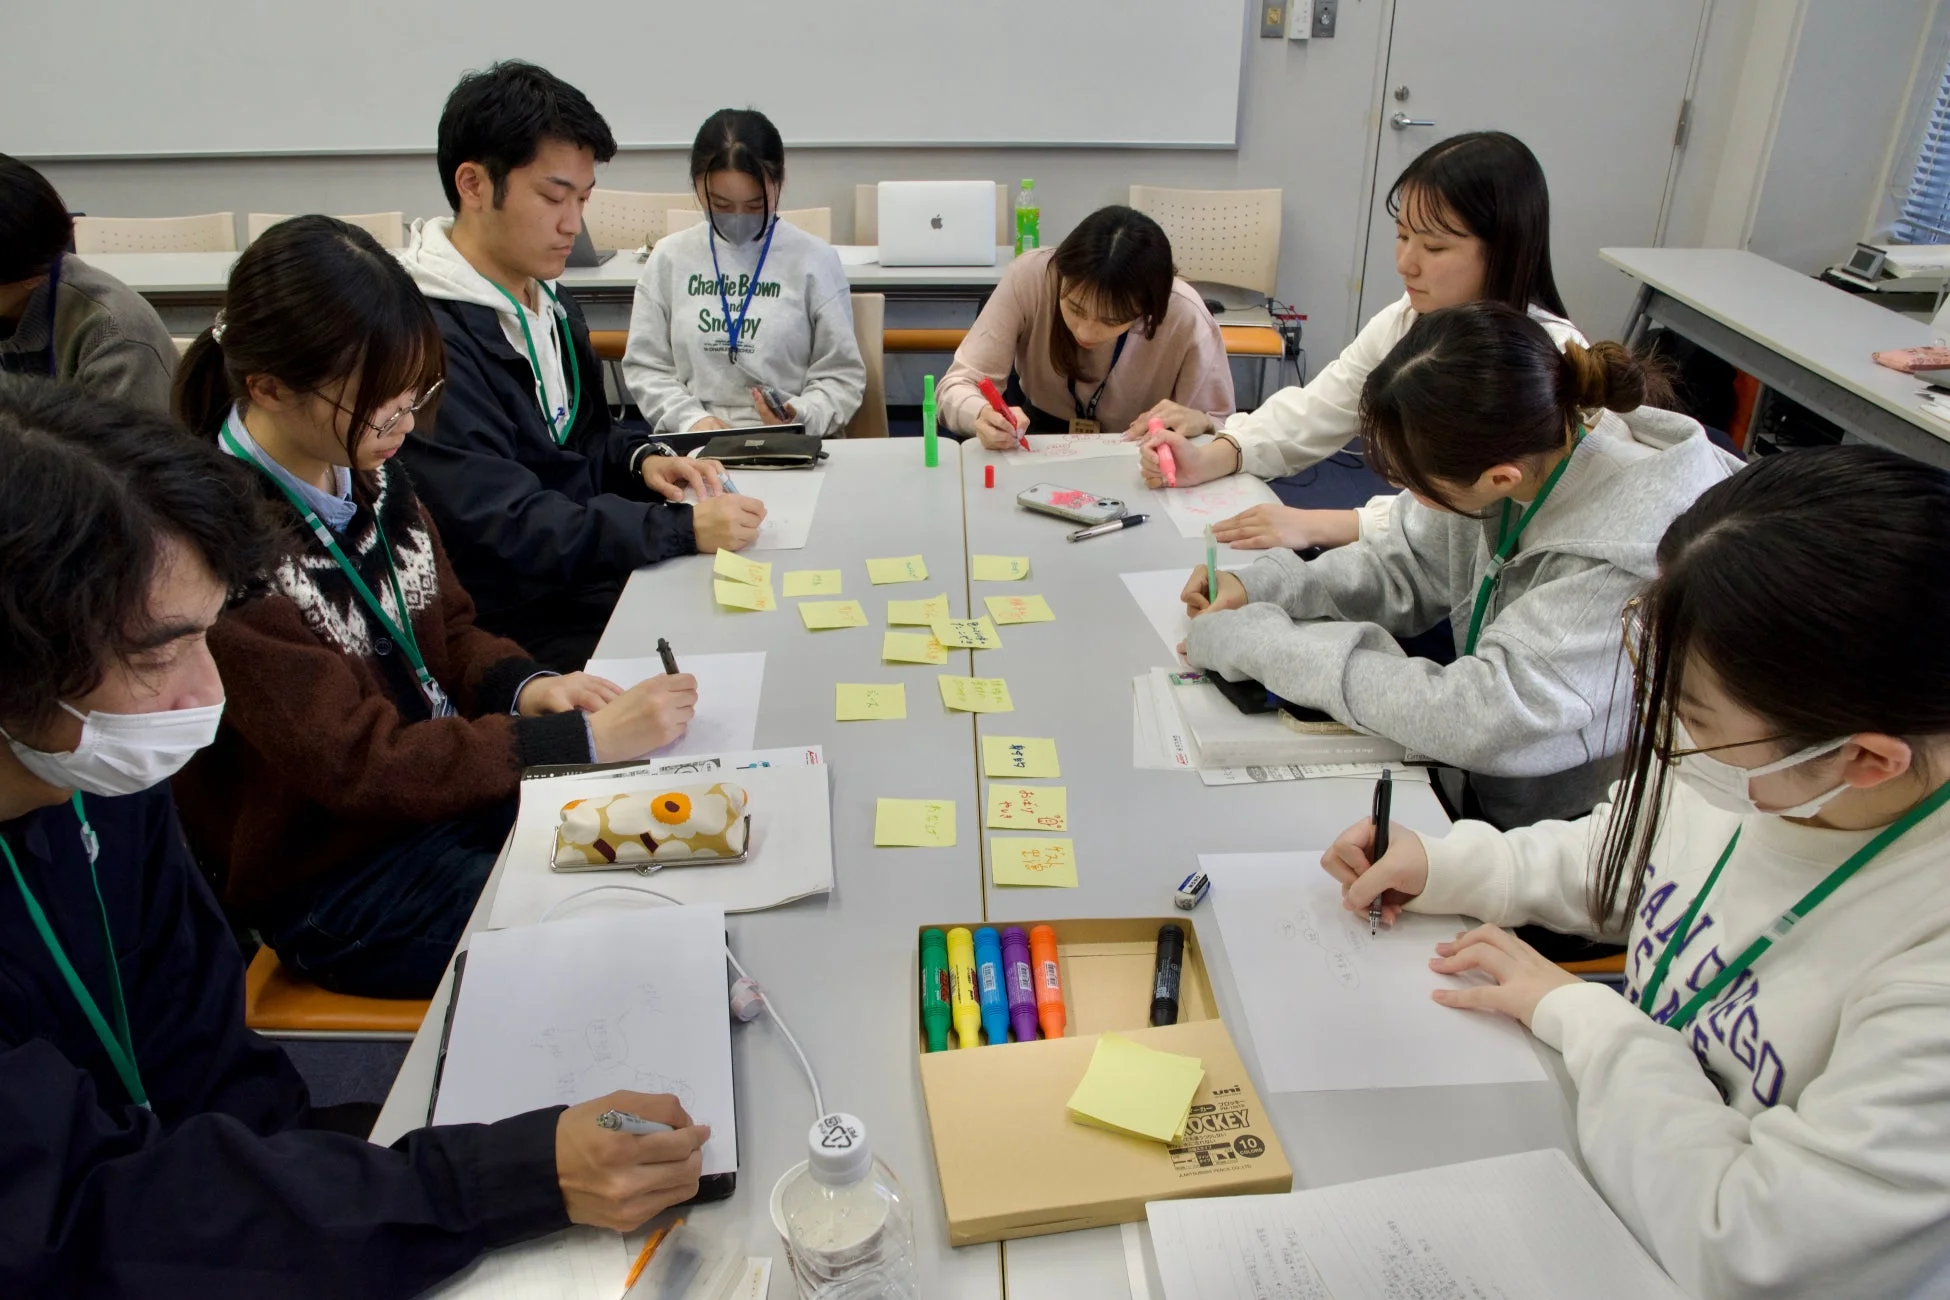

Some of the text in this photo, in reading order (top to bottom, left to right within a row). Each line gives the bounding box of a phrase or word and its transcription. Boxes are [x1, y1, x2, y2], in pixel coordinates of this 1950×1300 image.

[688, 273, 781, 298] Charlie Bown
[721, 298, 745, 313] nd
[698, 308, 761, 340] Snopy
[1018, 789, 1039, 815] おばけ
[1686, 944, 1787, 1108] DIEGO
[1213, 1085, 1241, 1095] uni
[1189, 1104, 1214, 1113] ーカー
[1184, 1109, 1250, 1135] OCKEY
[1239, 1138, 1258, 1149] 10
